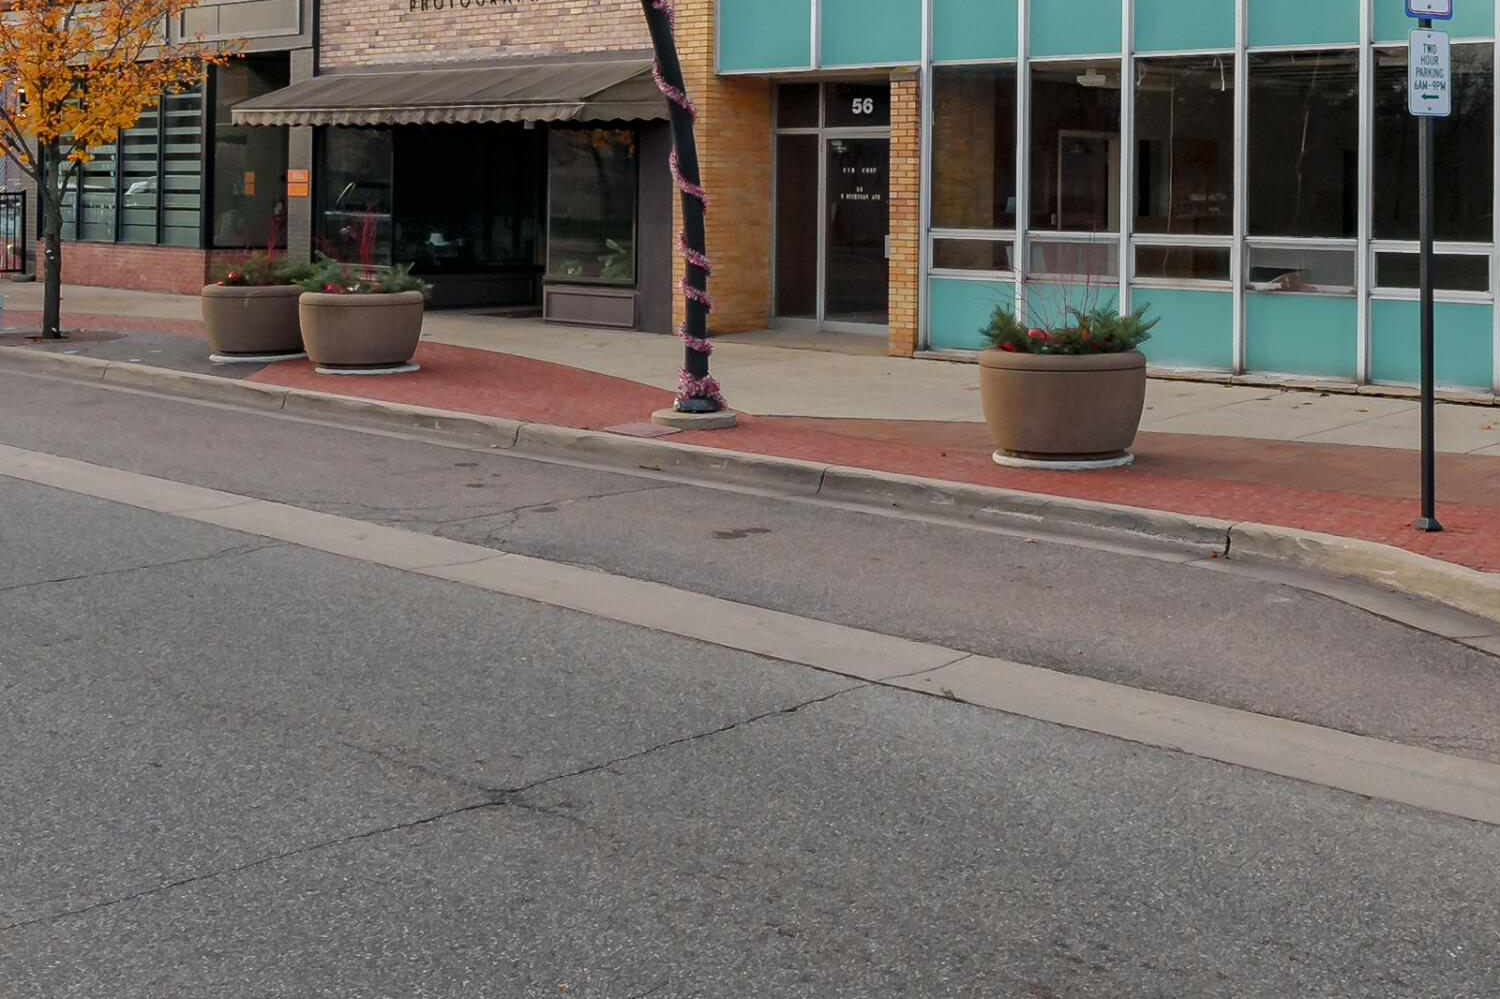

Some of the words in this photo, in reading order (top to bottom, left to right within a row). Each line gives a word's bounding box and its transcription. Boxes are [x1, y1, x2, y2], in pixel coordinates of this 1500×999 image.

[1423, 43, 1437, 54] TWO
[1420, 55, 1440, 66] HOUR
[1415, 66, 1444, 79] PARKING
[852, 97, 874, 114] 56
